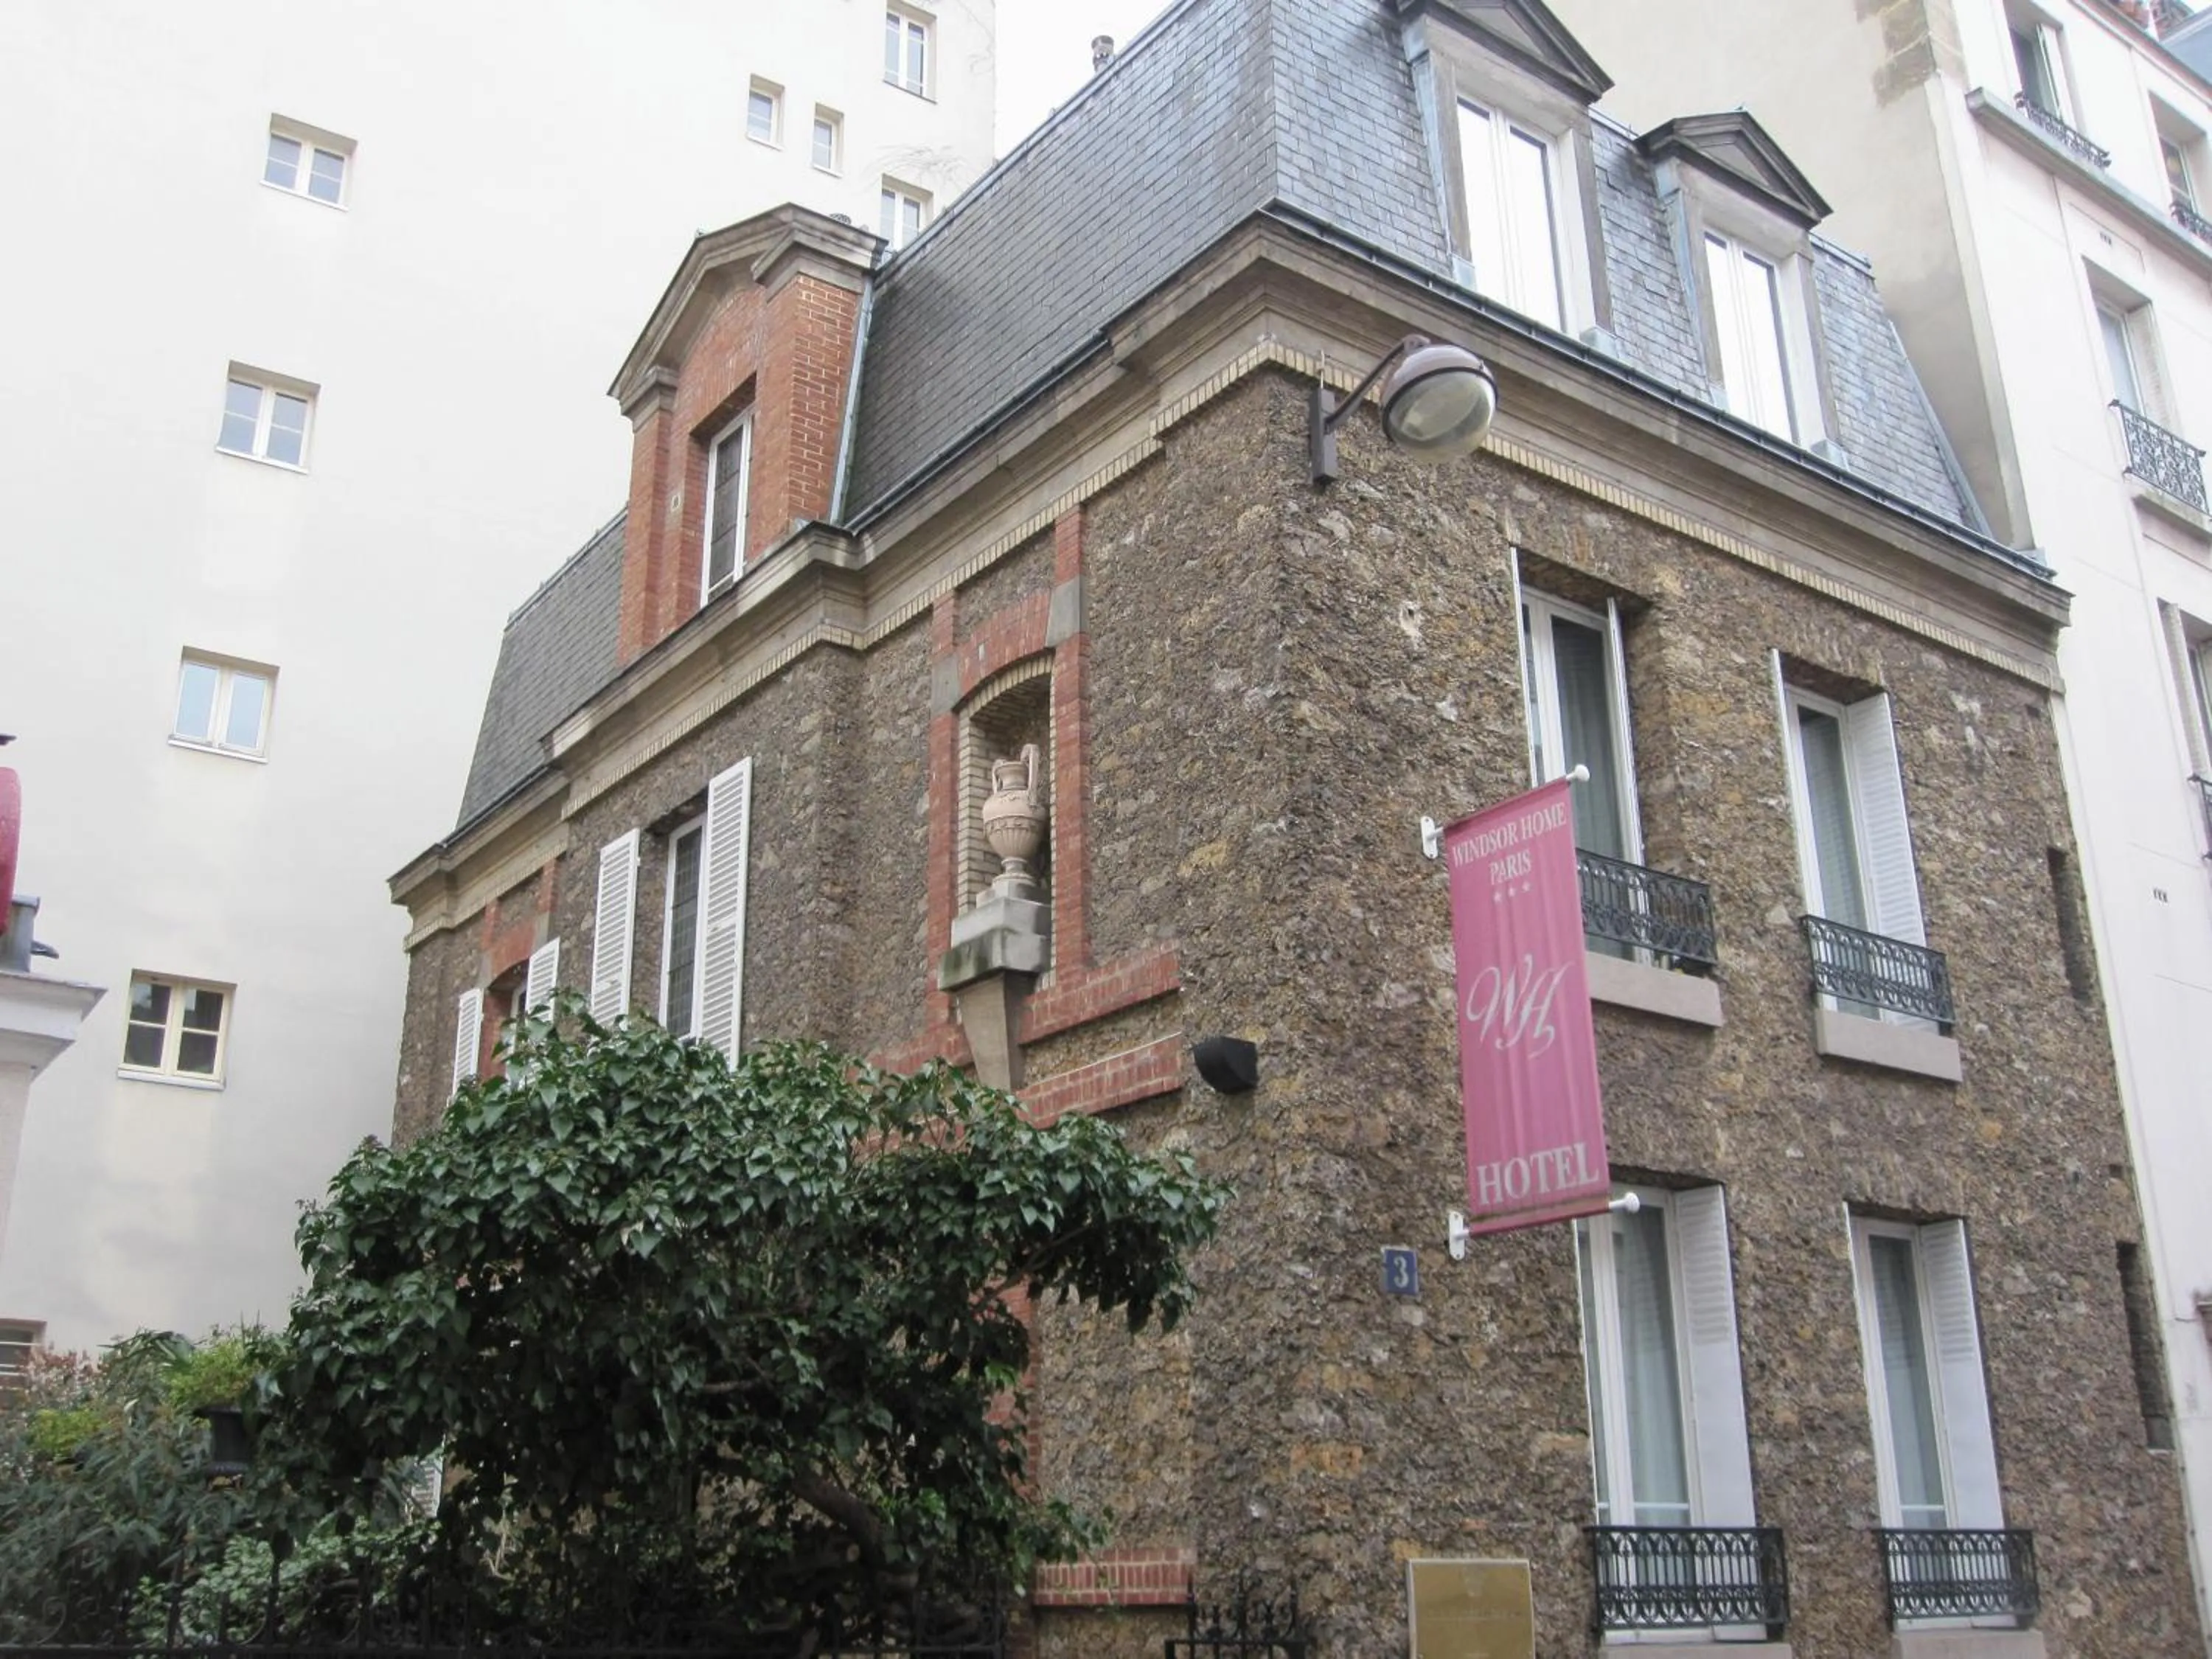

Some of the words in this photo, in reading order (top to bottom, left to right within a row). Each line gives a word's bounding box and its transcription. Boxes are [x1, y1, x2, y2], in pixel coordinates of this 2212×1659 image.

[1452, 821, 1519, 867] WINDSOR
[1520, 803, 1566, 841] HOME
[1489, 849, 1531, 885] PARIS
[1476, 1142, 1599, 1205] HOTEL
[1394, 1256, 1409, 1288] 3
